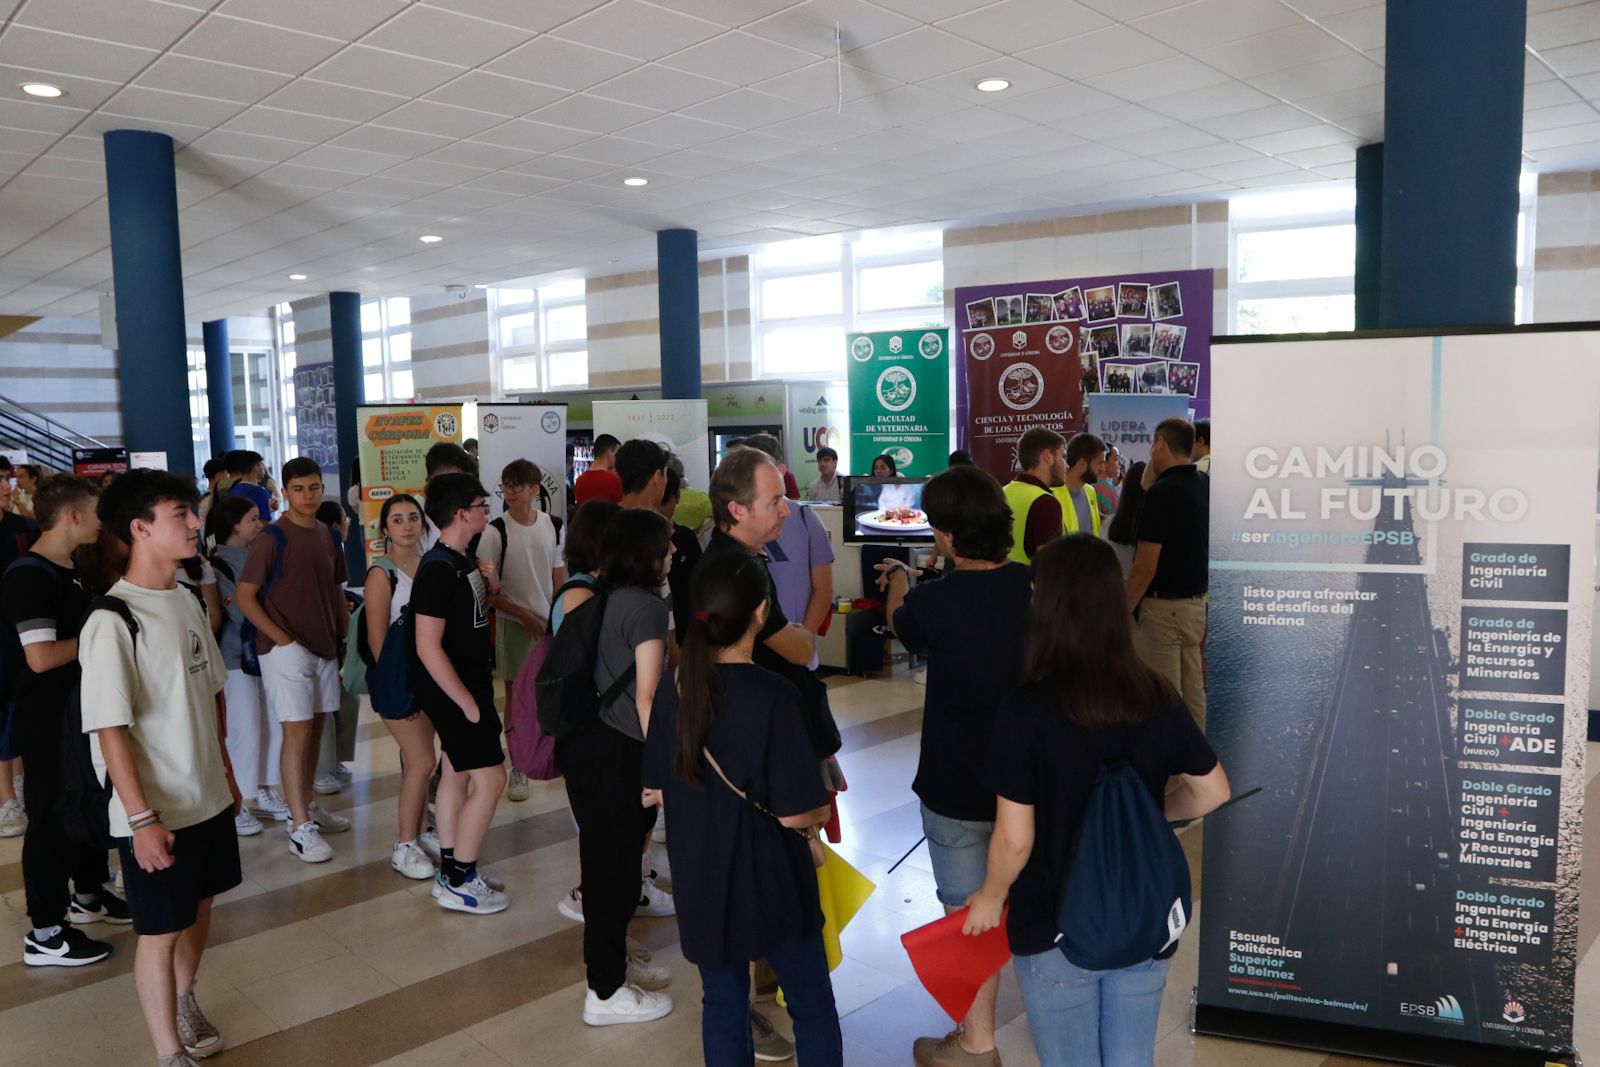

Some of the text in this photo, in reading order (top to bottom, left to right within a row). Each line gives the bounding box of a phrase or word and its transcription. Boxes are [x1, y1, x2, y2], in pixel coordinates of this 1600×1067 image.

[975, 415, 1007, 424] CIENCIA
[1016, 411, 1073, 422] TECNOLOGÍA
[877, 424, 928, 432] VETERINARIA
[984, 426, 994, 434] DE
[1101, 421, 1147, 431] LIDERA
[1101, 434, 1118, 443] TU
[1245, 445, 1447, 479] CAMINO
[1244, 487, 1528, 522] AL FUTURO
[1231, 530, 1414, 548] #seringenieroEPSB
[1470, 552, 1537, 563] Grado de
[1470, 565, 1547, 578] Ingeniería
[1470, 577, 1503, 588] Civil
[1244, 586, 1377, 601] listo para afrontar
[1244, 601, 1264, 611] los
[1330, 603, 1354, 614] del
[1243, 614, 1305, 626] mañana
[1468, 617, 1535, 628] Grado de
[1468, 630, 1561, 642] Ingeniería de
[1468, 642, 1554, 658] la Energía y
[1467, 655, 1535, 667] Recursos
[1467, 667, 1540, 680] Minerales
[1465, 709, 1555, 723] Doble Grado
[1464, 721, 1540, 735] Ingeniería
[1464, 734, 1496, 745] Civil
[1463, 747, 1500, 757] (NUEVO)
[1462, 780, 1552, 796] Doble Grado
[1462, 792, 1537, 808] Ingeniería
[1461, 805, 1494, 816] Civil
[1461, 817, 1537, 832] Ingeniería
[1460, 829, 1554, 848] de la Energía
[1460, 842, 1538, 858] y Recursos
[1460, 853, 1531, 870] Minerales
[1456, 890, 1545, 908] Doble Grado
[1456, 902, 1530, 919] Ingeniería
[1455, 914, 1548, 935] de la Energía
[1230, 930, 1280, 945] Escuela
[1230, 941, 1302, 959] Politécnica
[1454, 938, 1518, 954] Eléctrica
[1229, 952, 1285, 968] Superior
[1228, 964, 1295, 980] de Belmez
[1228, 987, 1368, 1012] www.uco.es/politecnica-belmez/es/
[1400, 1002, 1436, 1016] EPSB
